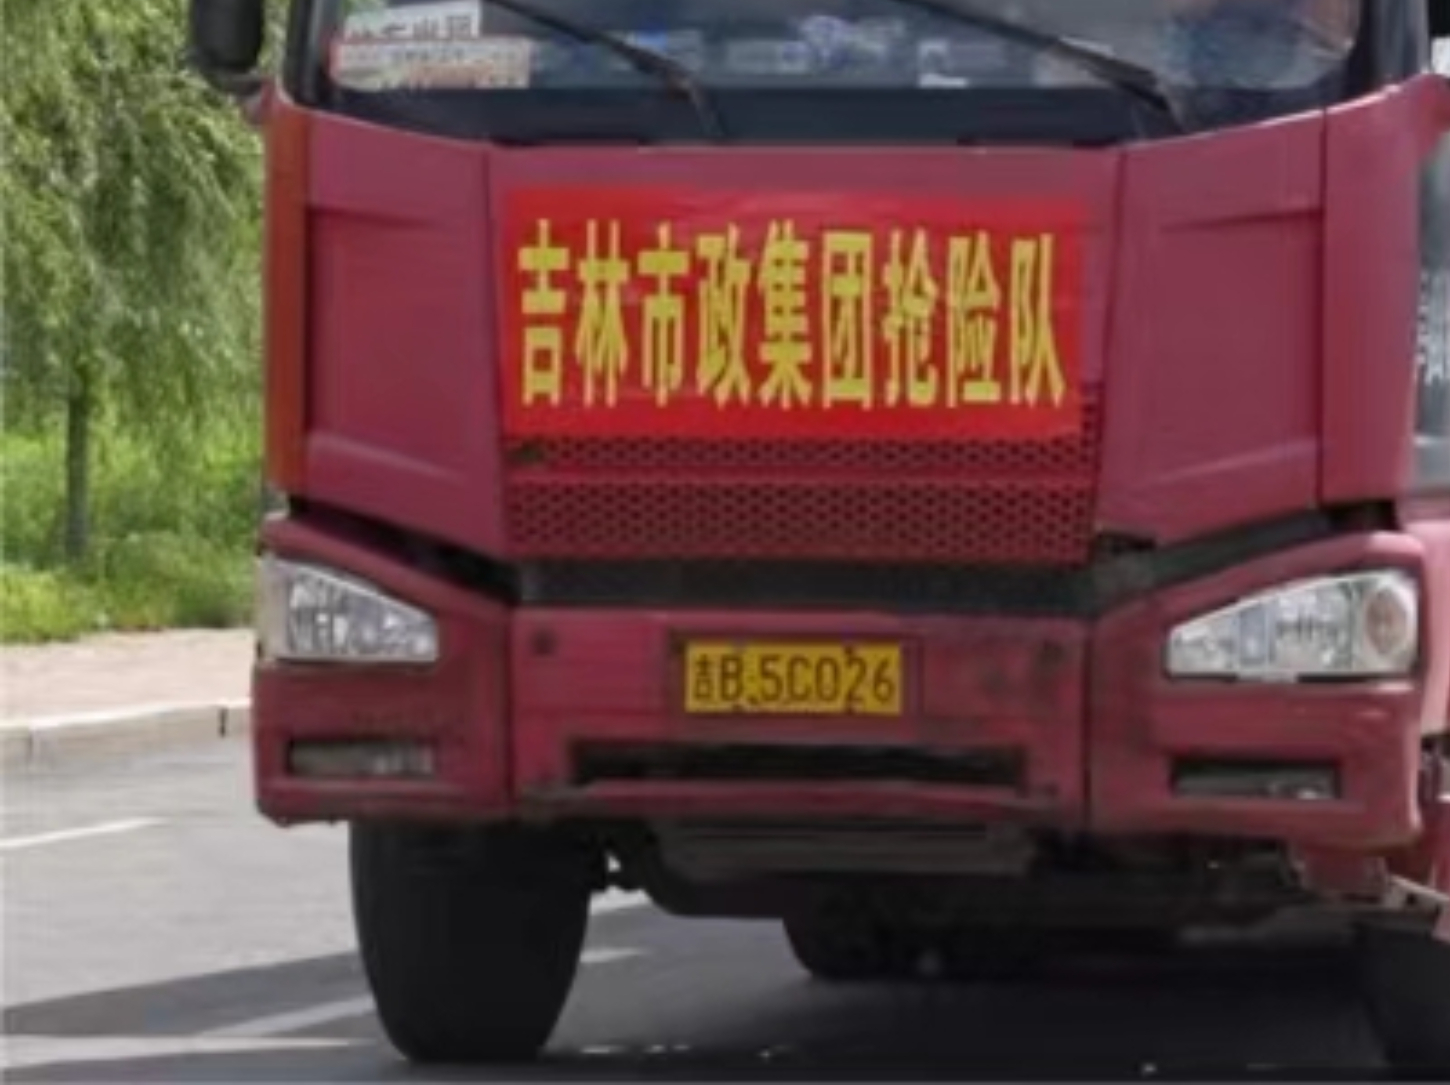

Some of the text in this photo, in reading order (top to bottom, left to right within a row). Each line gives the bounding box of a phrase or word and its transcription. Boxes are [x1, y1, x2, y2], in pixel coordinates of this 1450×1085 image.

[518, 218, 1065, 409] 吉林市政集团抢险队
